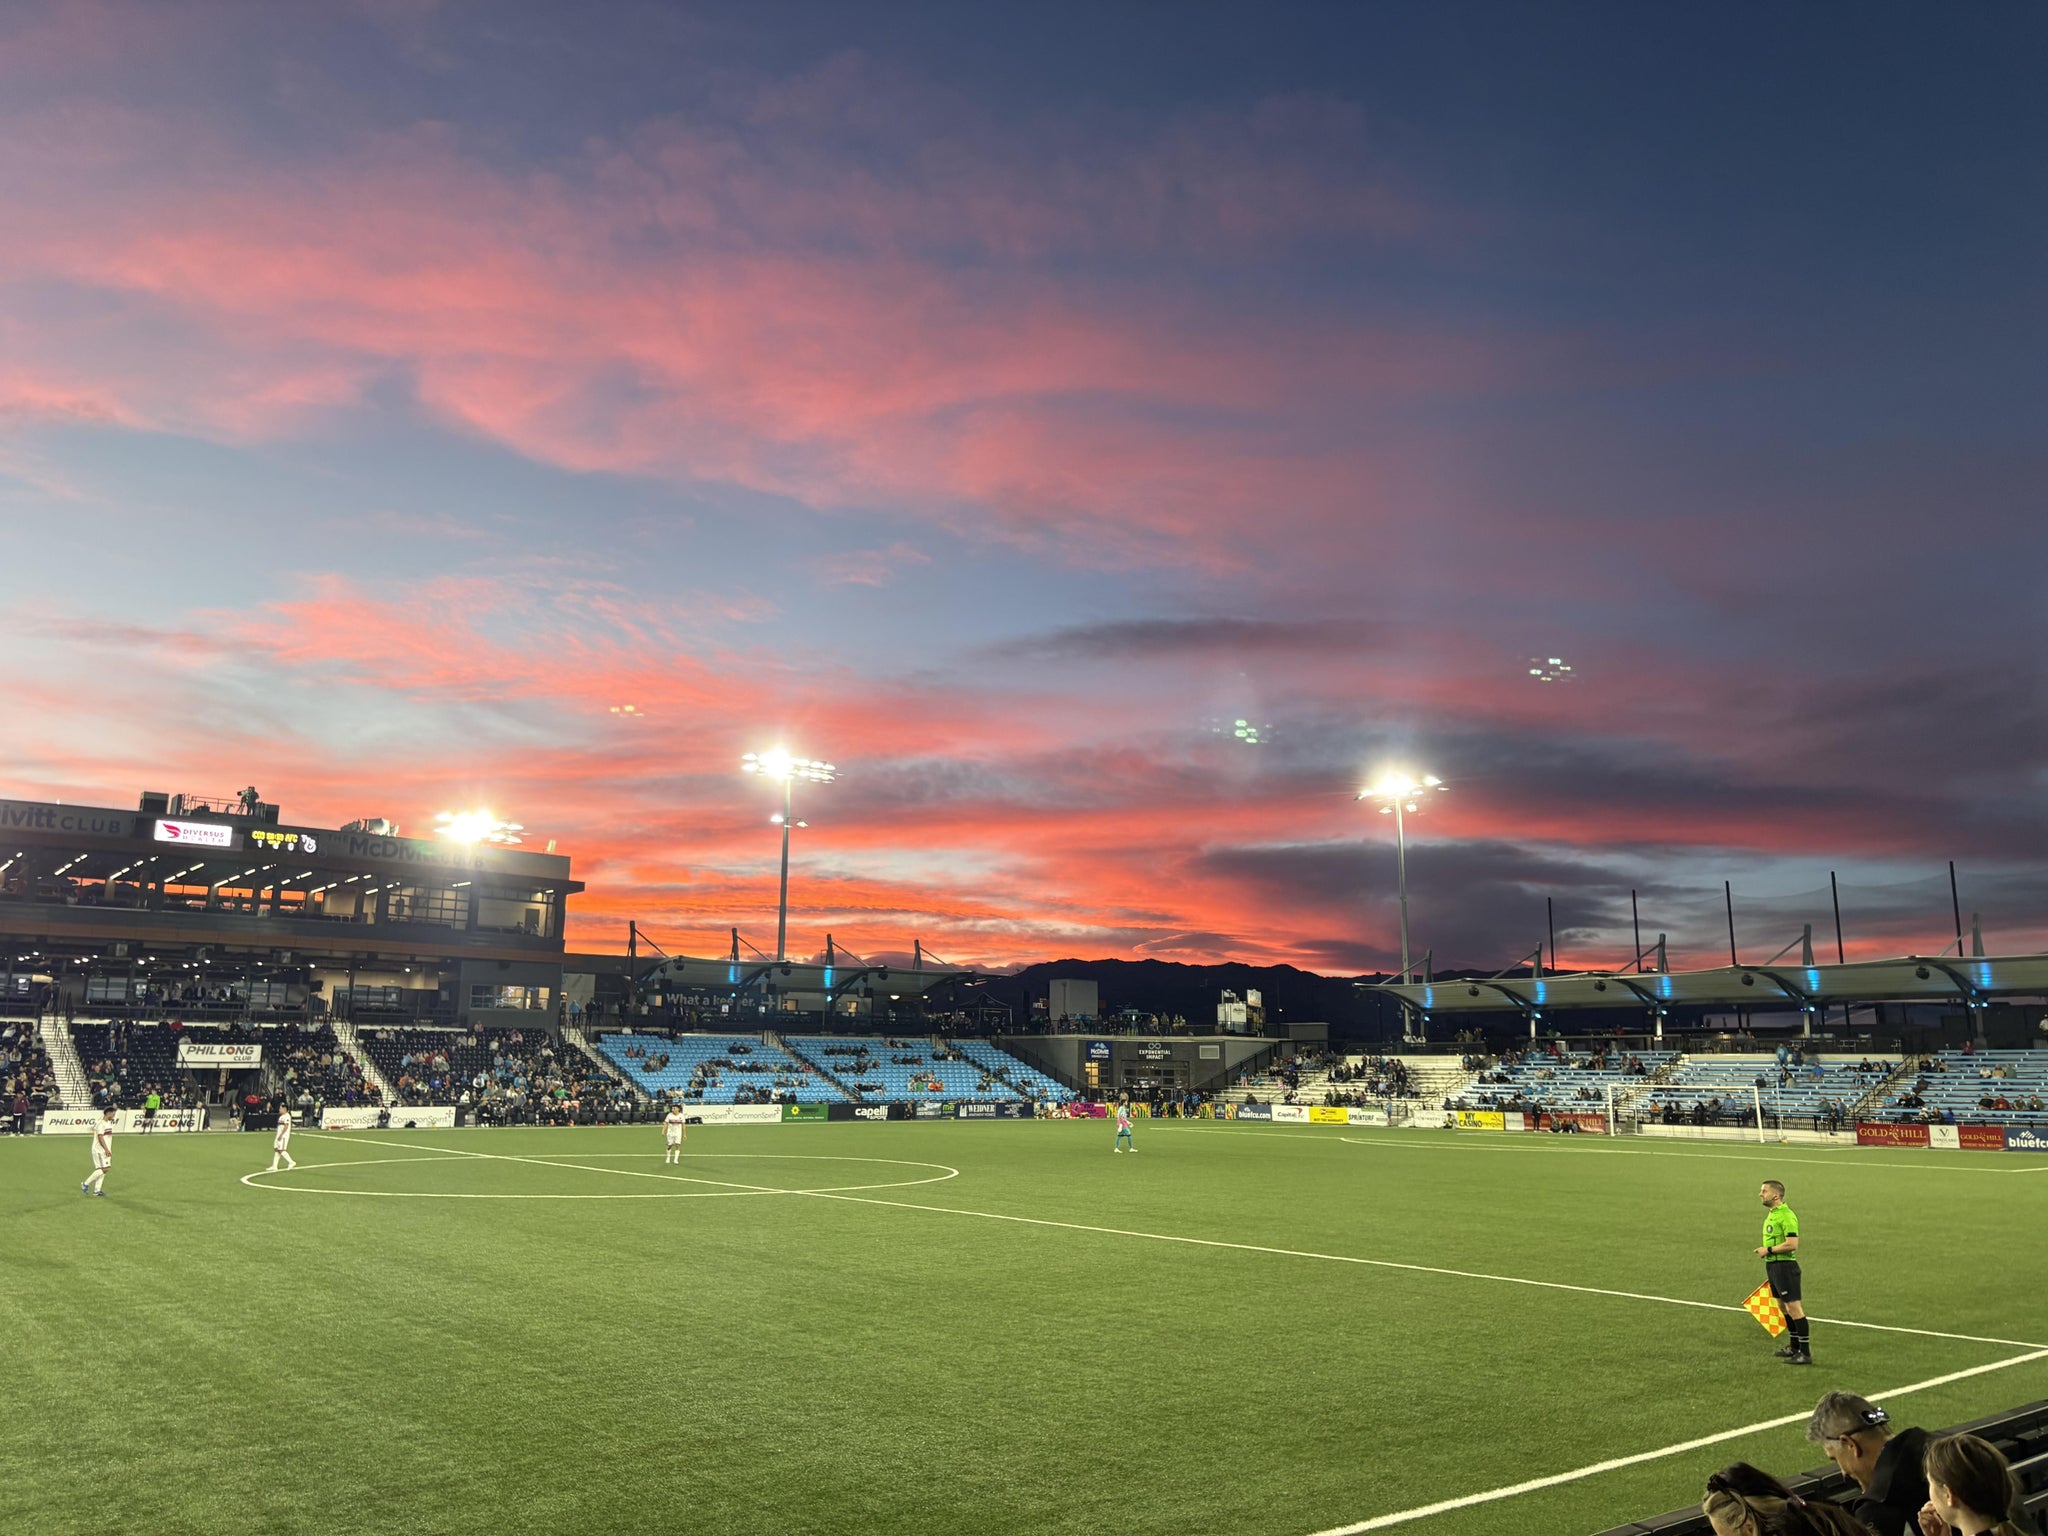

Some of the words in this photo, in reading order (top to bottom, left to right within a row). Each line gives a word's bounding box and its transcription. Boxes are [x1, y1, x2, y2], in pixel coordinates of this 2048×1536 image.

[0, 804, 56, 829] ivitt
[60, 816, 121, 833] CLUB
[183, 828, 225, 838] DIVERSUS
[327, 833, 347, 842] THE
[666, 993, 701, 1006] What
[702, 996, 710, 1005] a
[713, 994, 756, 1007] keeer.
[186, 1046, 216, 1055] PHIL
[218, 1046, 254, 1055] LONG
[854, 1105, 888, 1118] capelli
[968, 1104, 995, 1113] WEIDNER
[733, 1112, 777, 1120] CommonSpirit
[1238, 1111, 1271, 1120] bluefcu.com
[1464, 1112, 1475, 1121] MY
[1458, 1120, 1483, 1128] CASINO
[1859, 1128, 1888, 1137] GOLD
[1900, 1129, 1927, 1139] HILL
